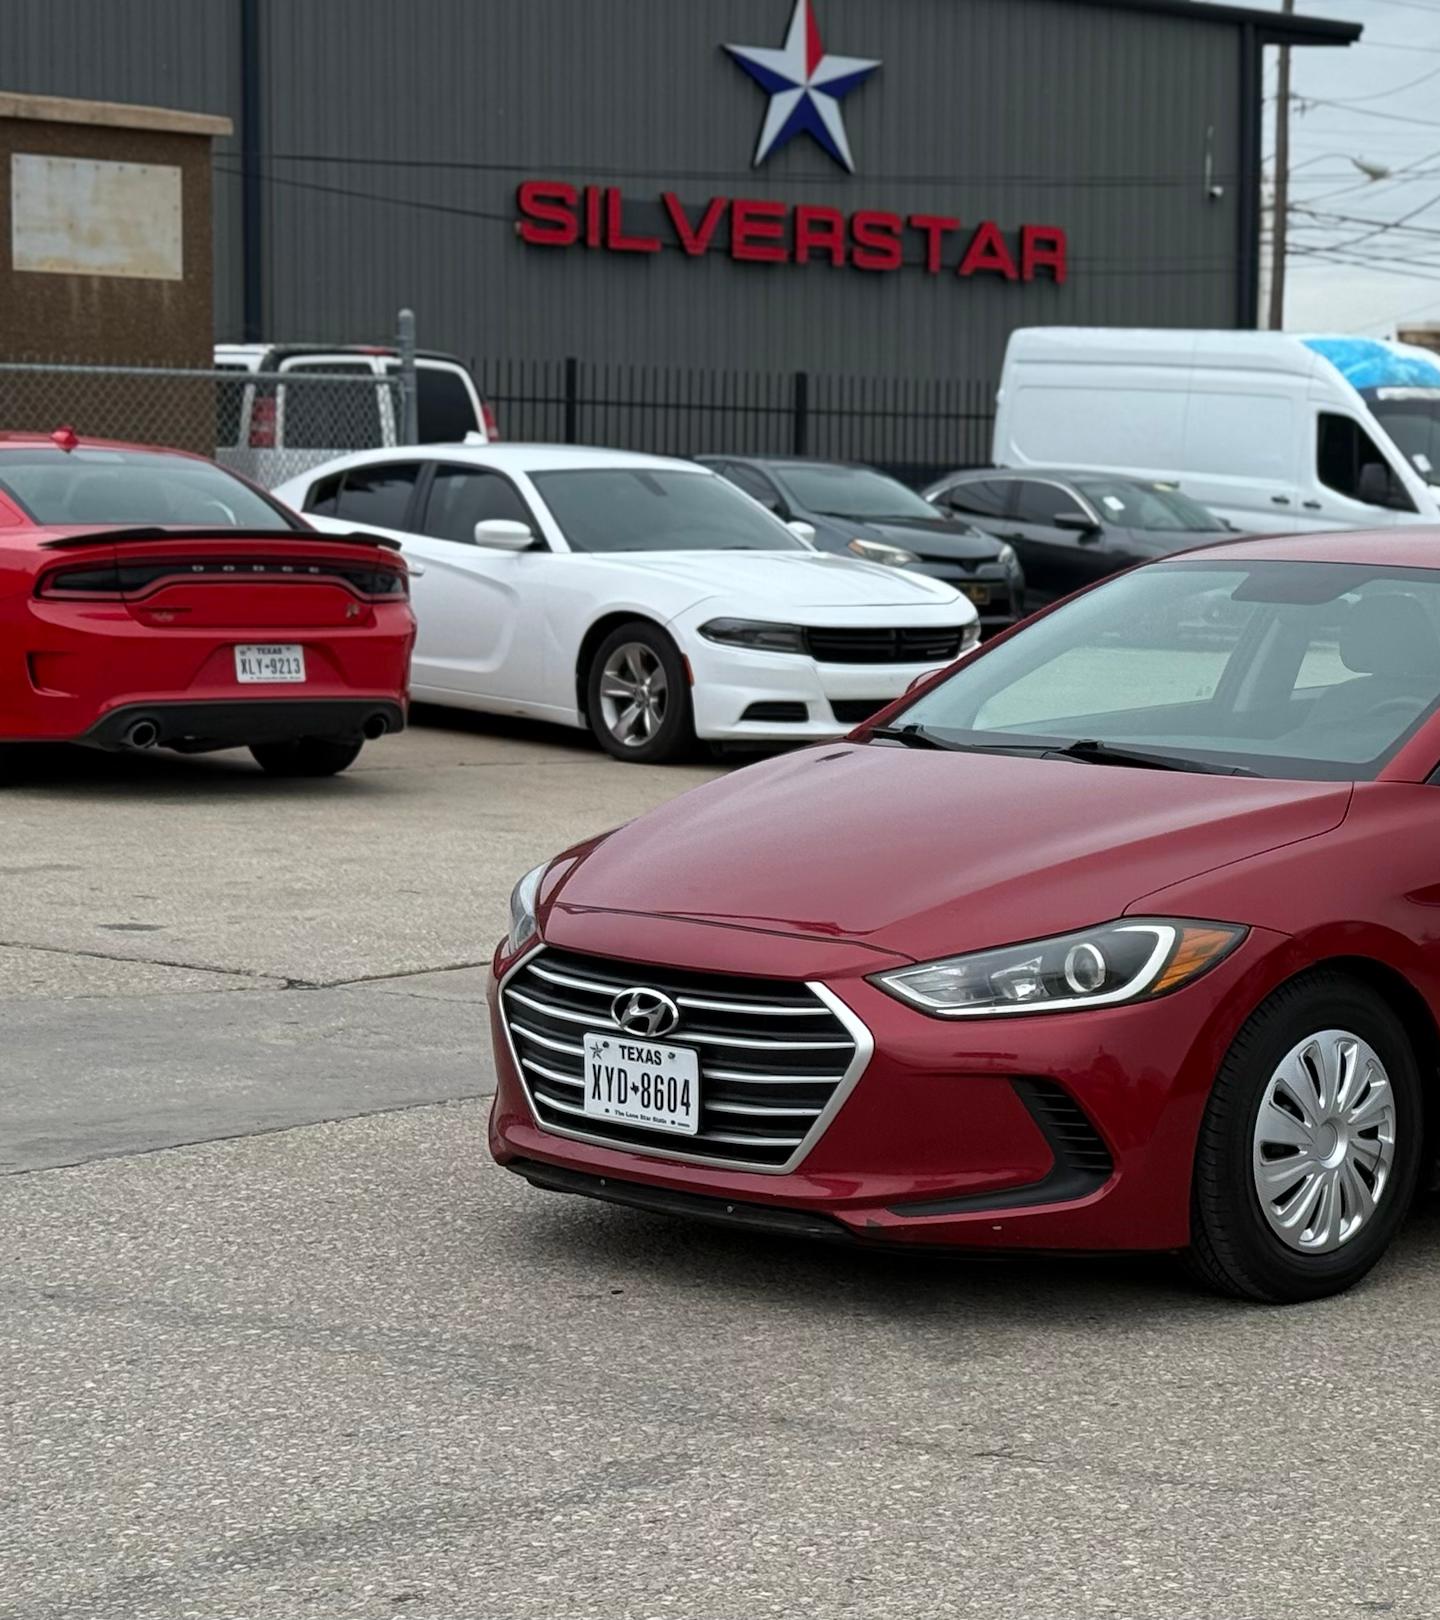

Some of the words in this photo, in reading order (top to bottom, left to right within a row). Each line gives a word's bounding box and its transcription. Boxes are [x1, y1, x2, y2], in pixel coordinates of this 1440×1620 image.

[517, 180, 1067, 284] SILVERSTAR
[256, 647, 282, 655] TEXAS
[618, 1044, 662, 1066] TEXAS
